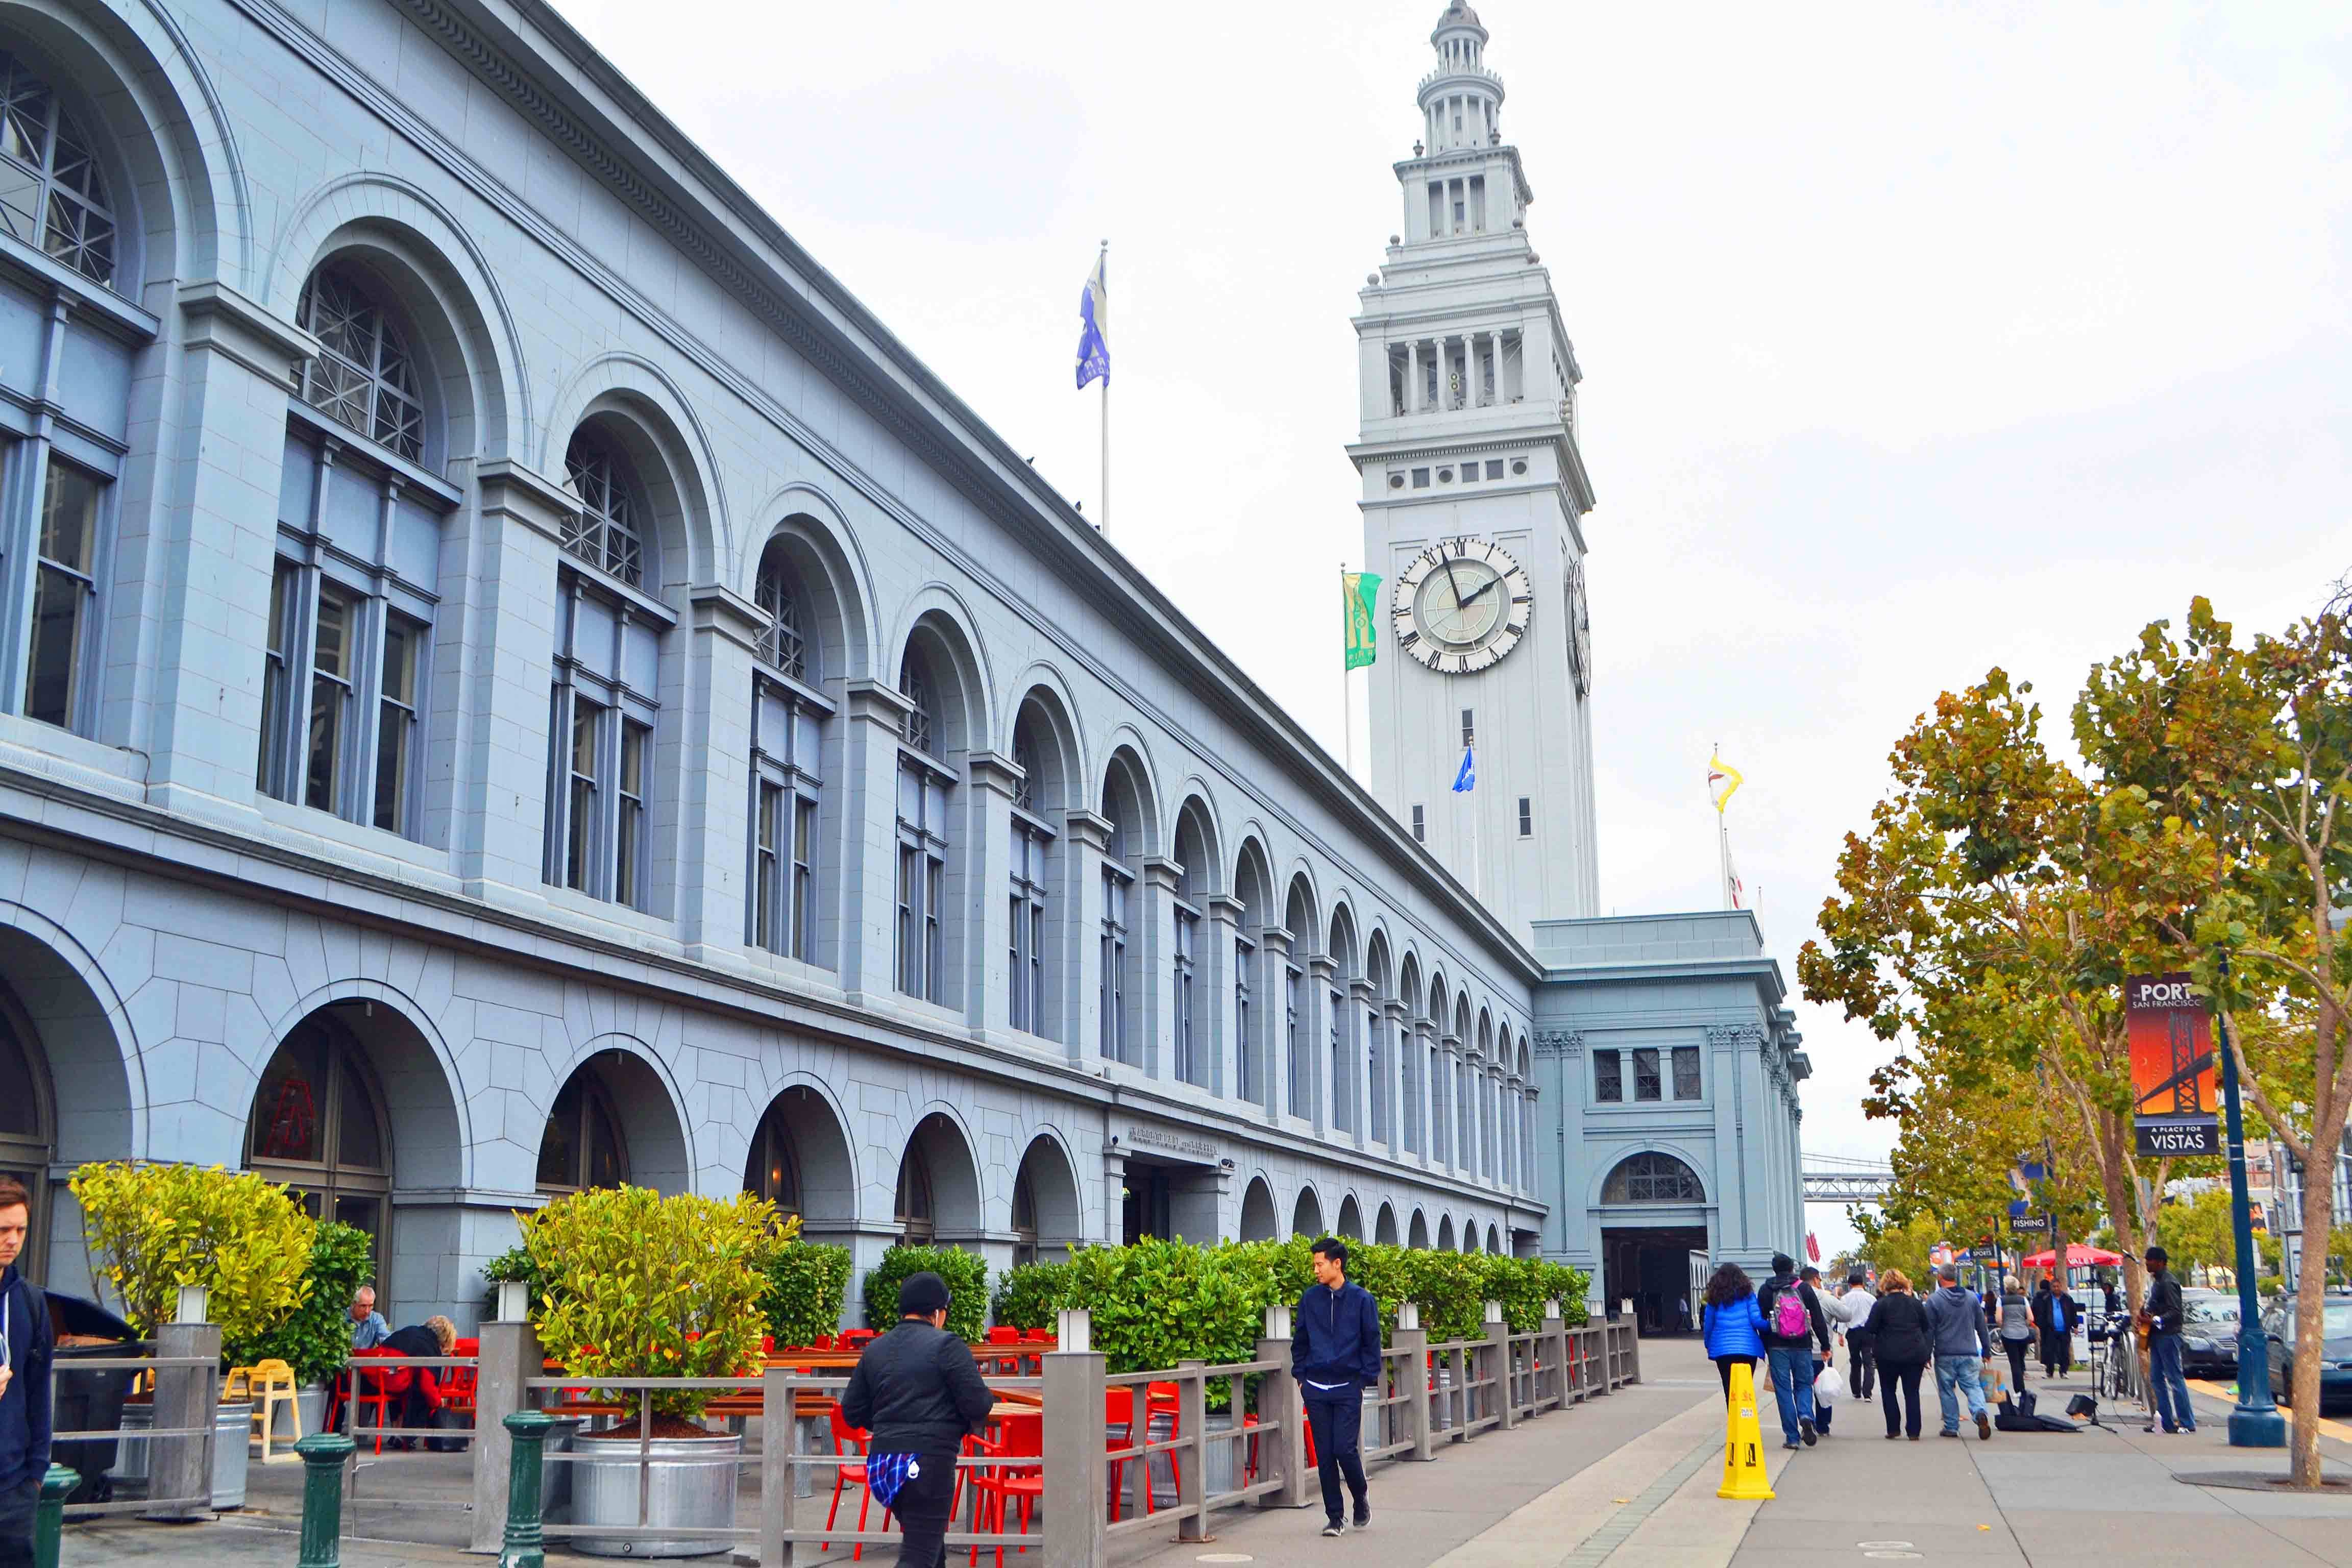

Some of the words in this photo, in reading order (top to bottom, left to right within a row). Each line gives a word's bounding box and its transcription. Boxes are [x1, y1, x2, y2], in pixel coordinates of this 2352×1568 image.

[2141, 983, 2192, 1001] PORT
[2150, 1134, 2205, 1150] VISTAS
[2013, 1219, 2045, 1228] FISHING
